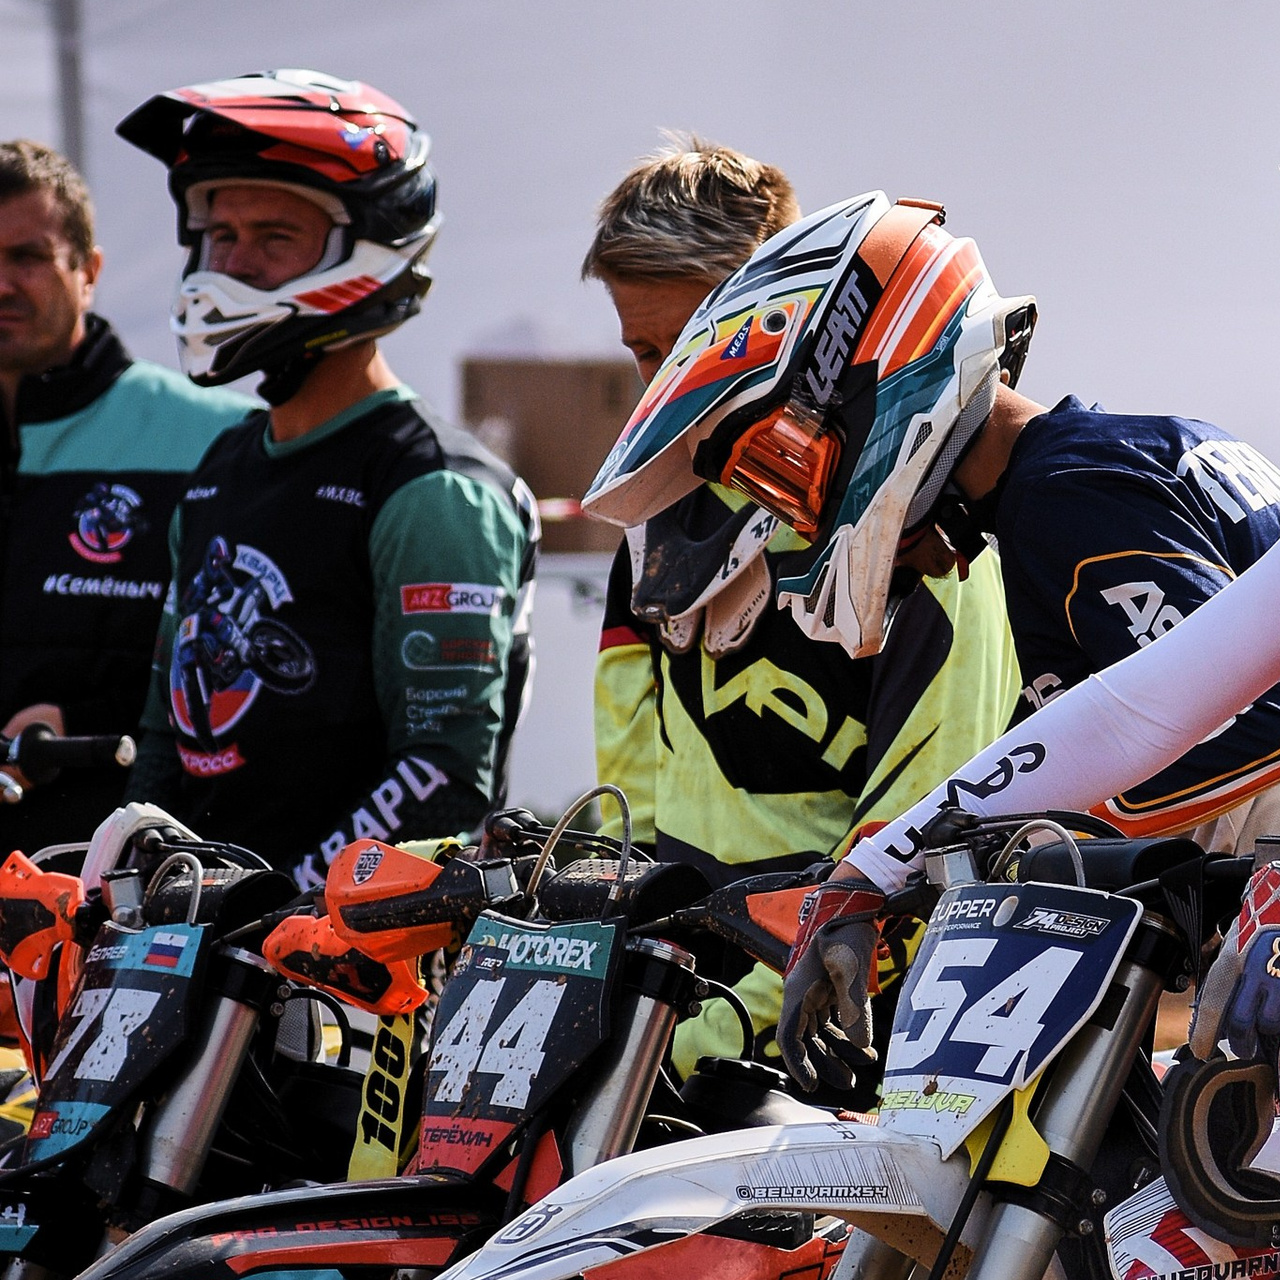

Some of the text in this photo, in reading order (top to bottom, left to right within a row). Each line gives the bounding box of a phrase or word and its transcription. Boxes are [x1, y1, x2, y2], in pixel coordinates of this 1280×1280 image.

[806, 269, 871, 405] LEATT
[1057, 913, 1105, 932] DESIGN
[42, 987, 163, 1083] 78
[429, 976, 570, 1111] 44
[885, 938, 1084, 1078] 54
[881, 1089, 977, 1114] BELOVA
[754, 1185, 889, 1200] BELOVAMX54
